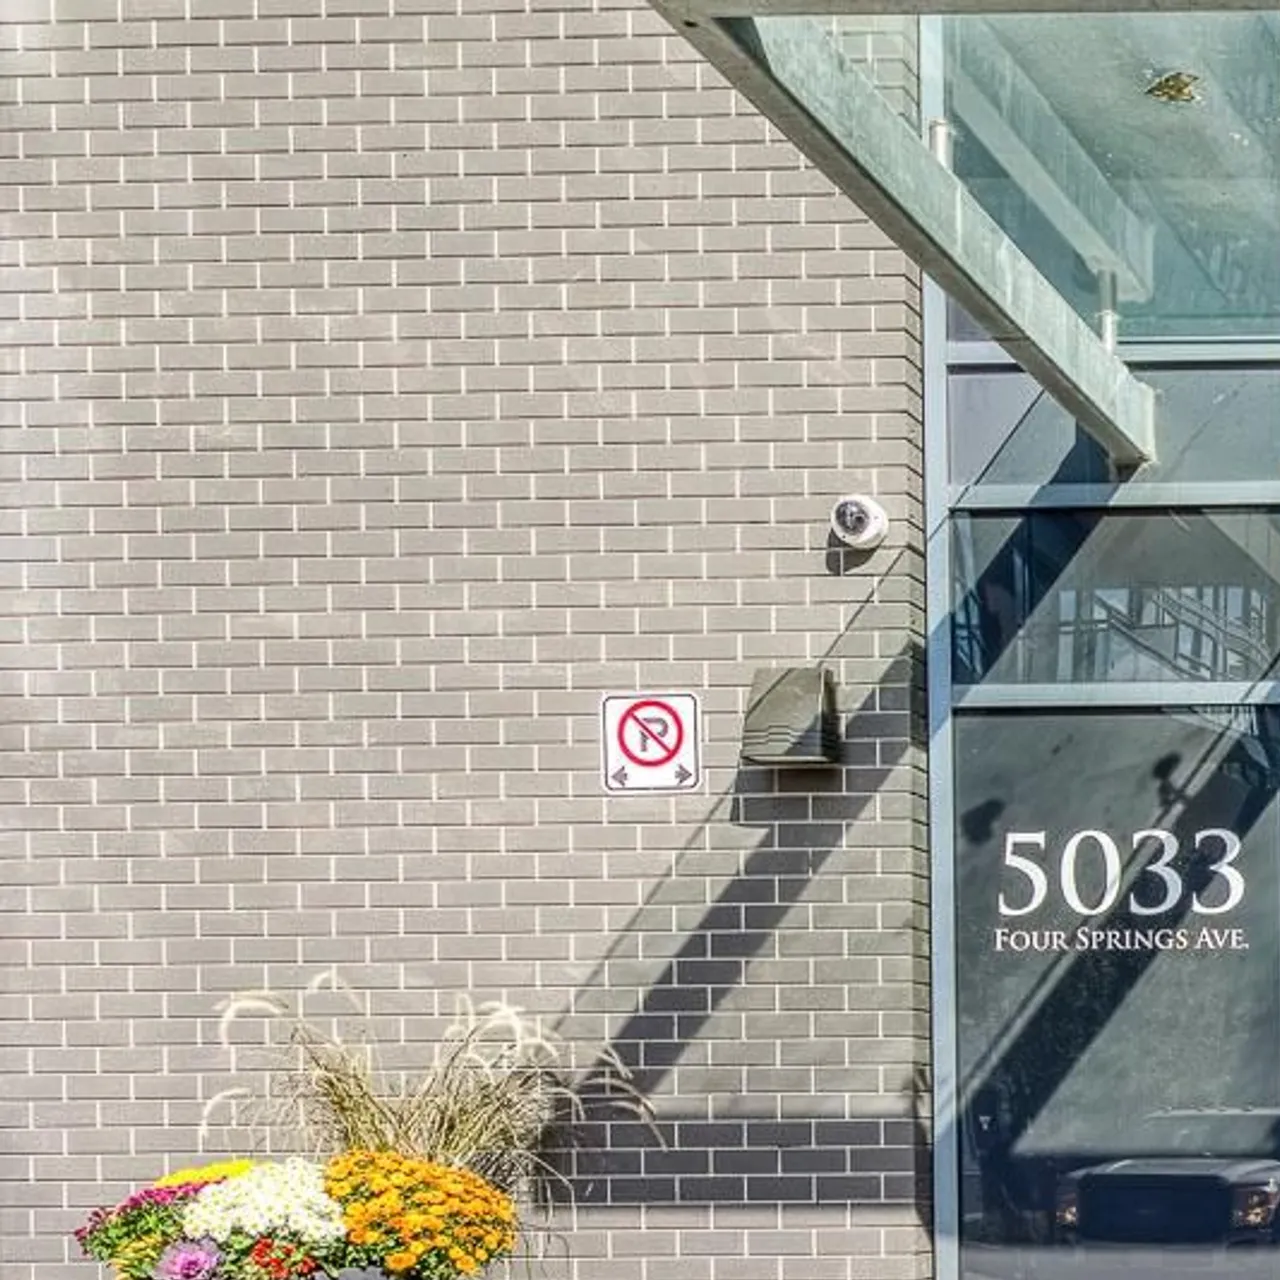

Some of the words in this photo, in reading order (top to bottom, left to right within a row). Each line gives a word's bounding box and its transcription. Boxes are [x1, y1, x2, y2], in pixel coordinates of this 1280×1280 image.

[998, 828, 1245, 916] 5033
[995, 927, 1069, 951] FOUR
[1075, 926, 1188, 951] SPRINGS
[1194, 926, 1250, 950] AVE.
